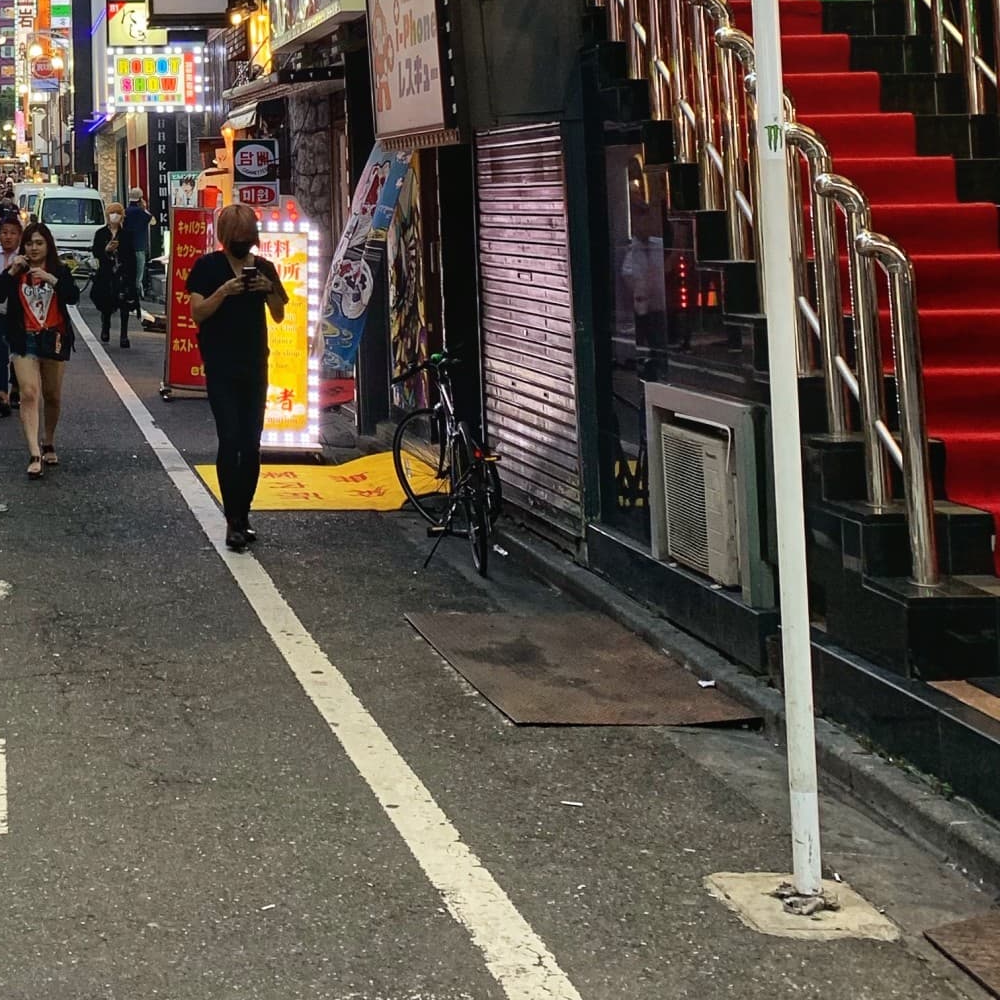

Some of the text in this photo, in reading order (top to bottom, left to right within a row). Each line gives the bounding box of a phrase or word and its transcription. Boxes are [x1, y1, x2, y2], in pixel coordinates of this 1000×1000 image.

[117, 58, 181, 76] ROBOT
[121, 76, 178, 94] SHOW
[242, 188, 269, 203] 미원
[177, 220, 207, 235] キャバクラ
